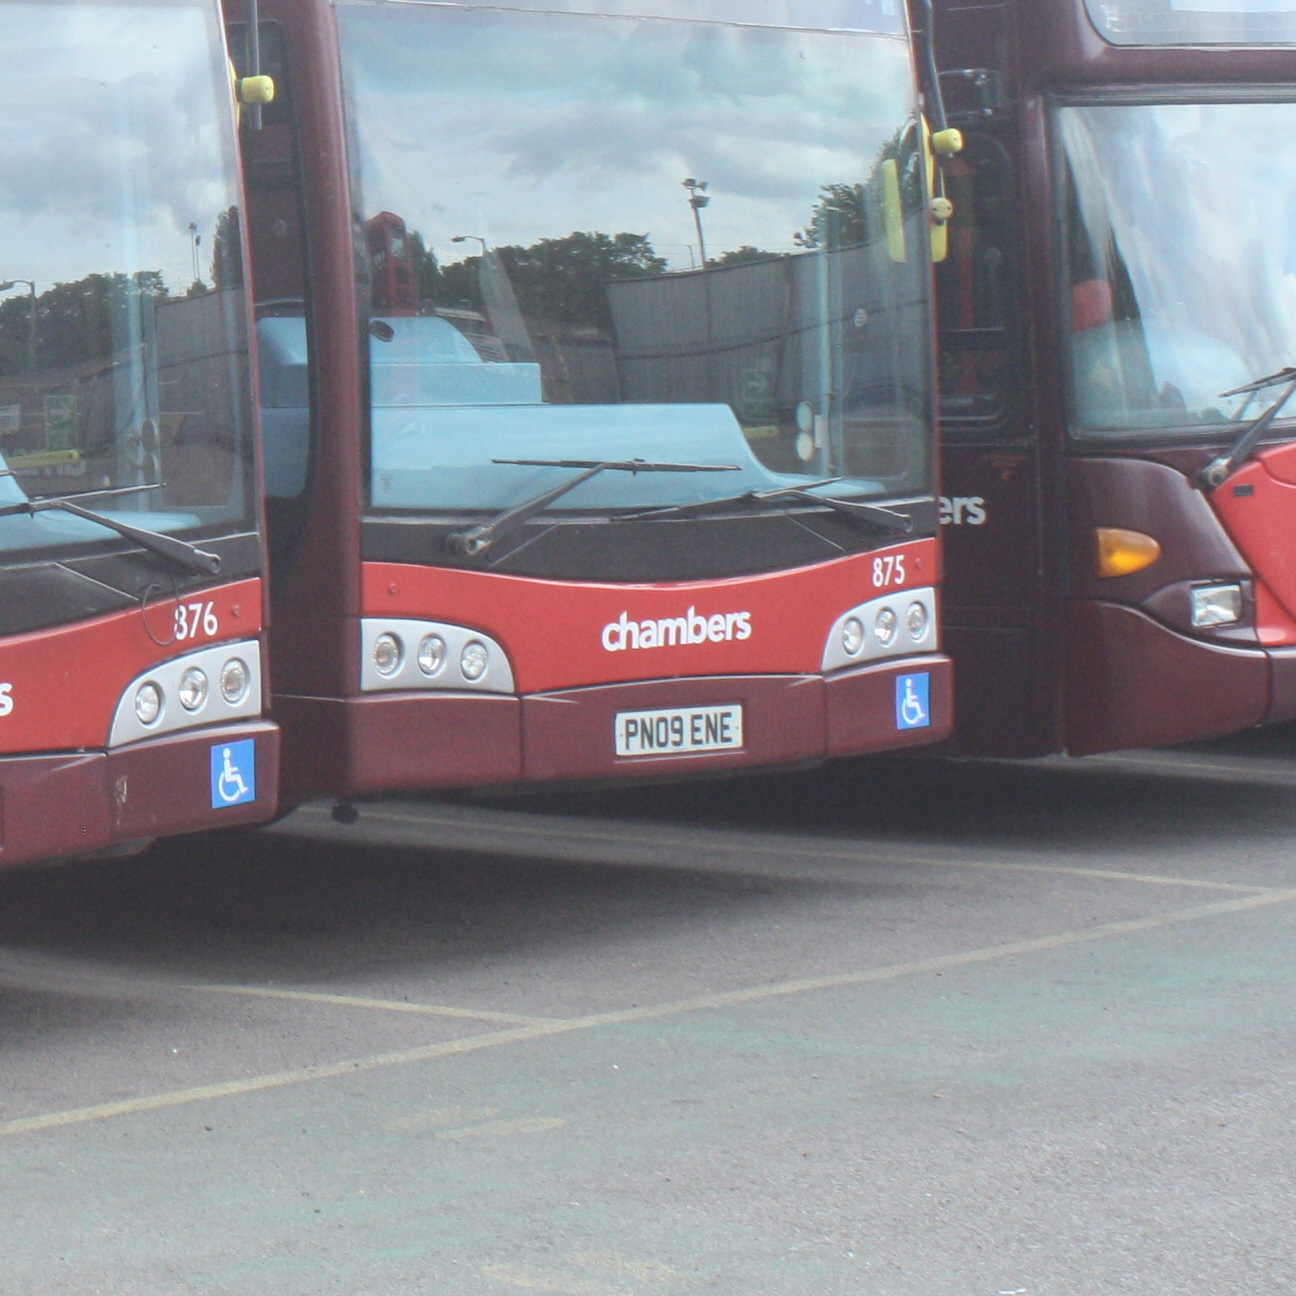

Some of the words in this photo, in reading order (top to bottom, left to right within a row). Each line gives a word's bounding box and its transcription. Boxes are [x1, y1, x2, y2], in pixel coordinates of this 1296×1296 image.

[872, 555, 905, 588] 875
[173, 601, 218, 641] 876
[601, 605, 752, 652] chambers
[625, 715, 684, 751] PN09
[690, 711, 732, 746] ENE
